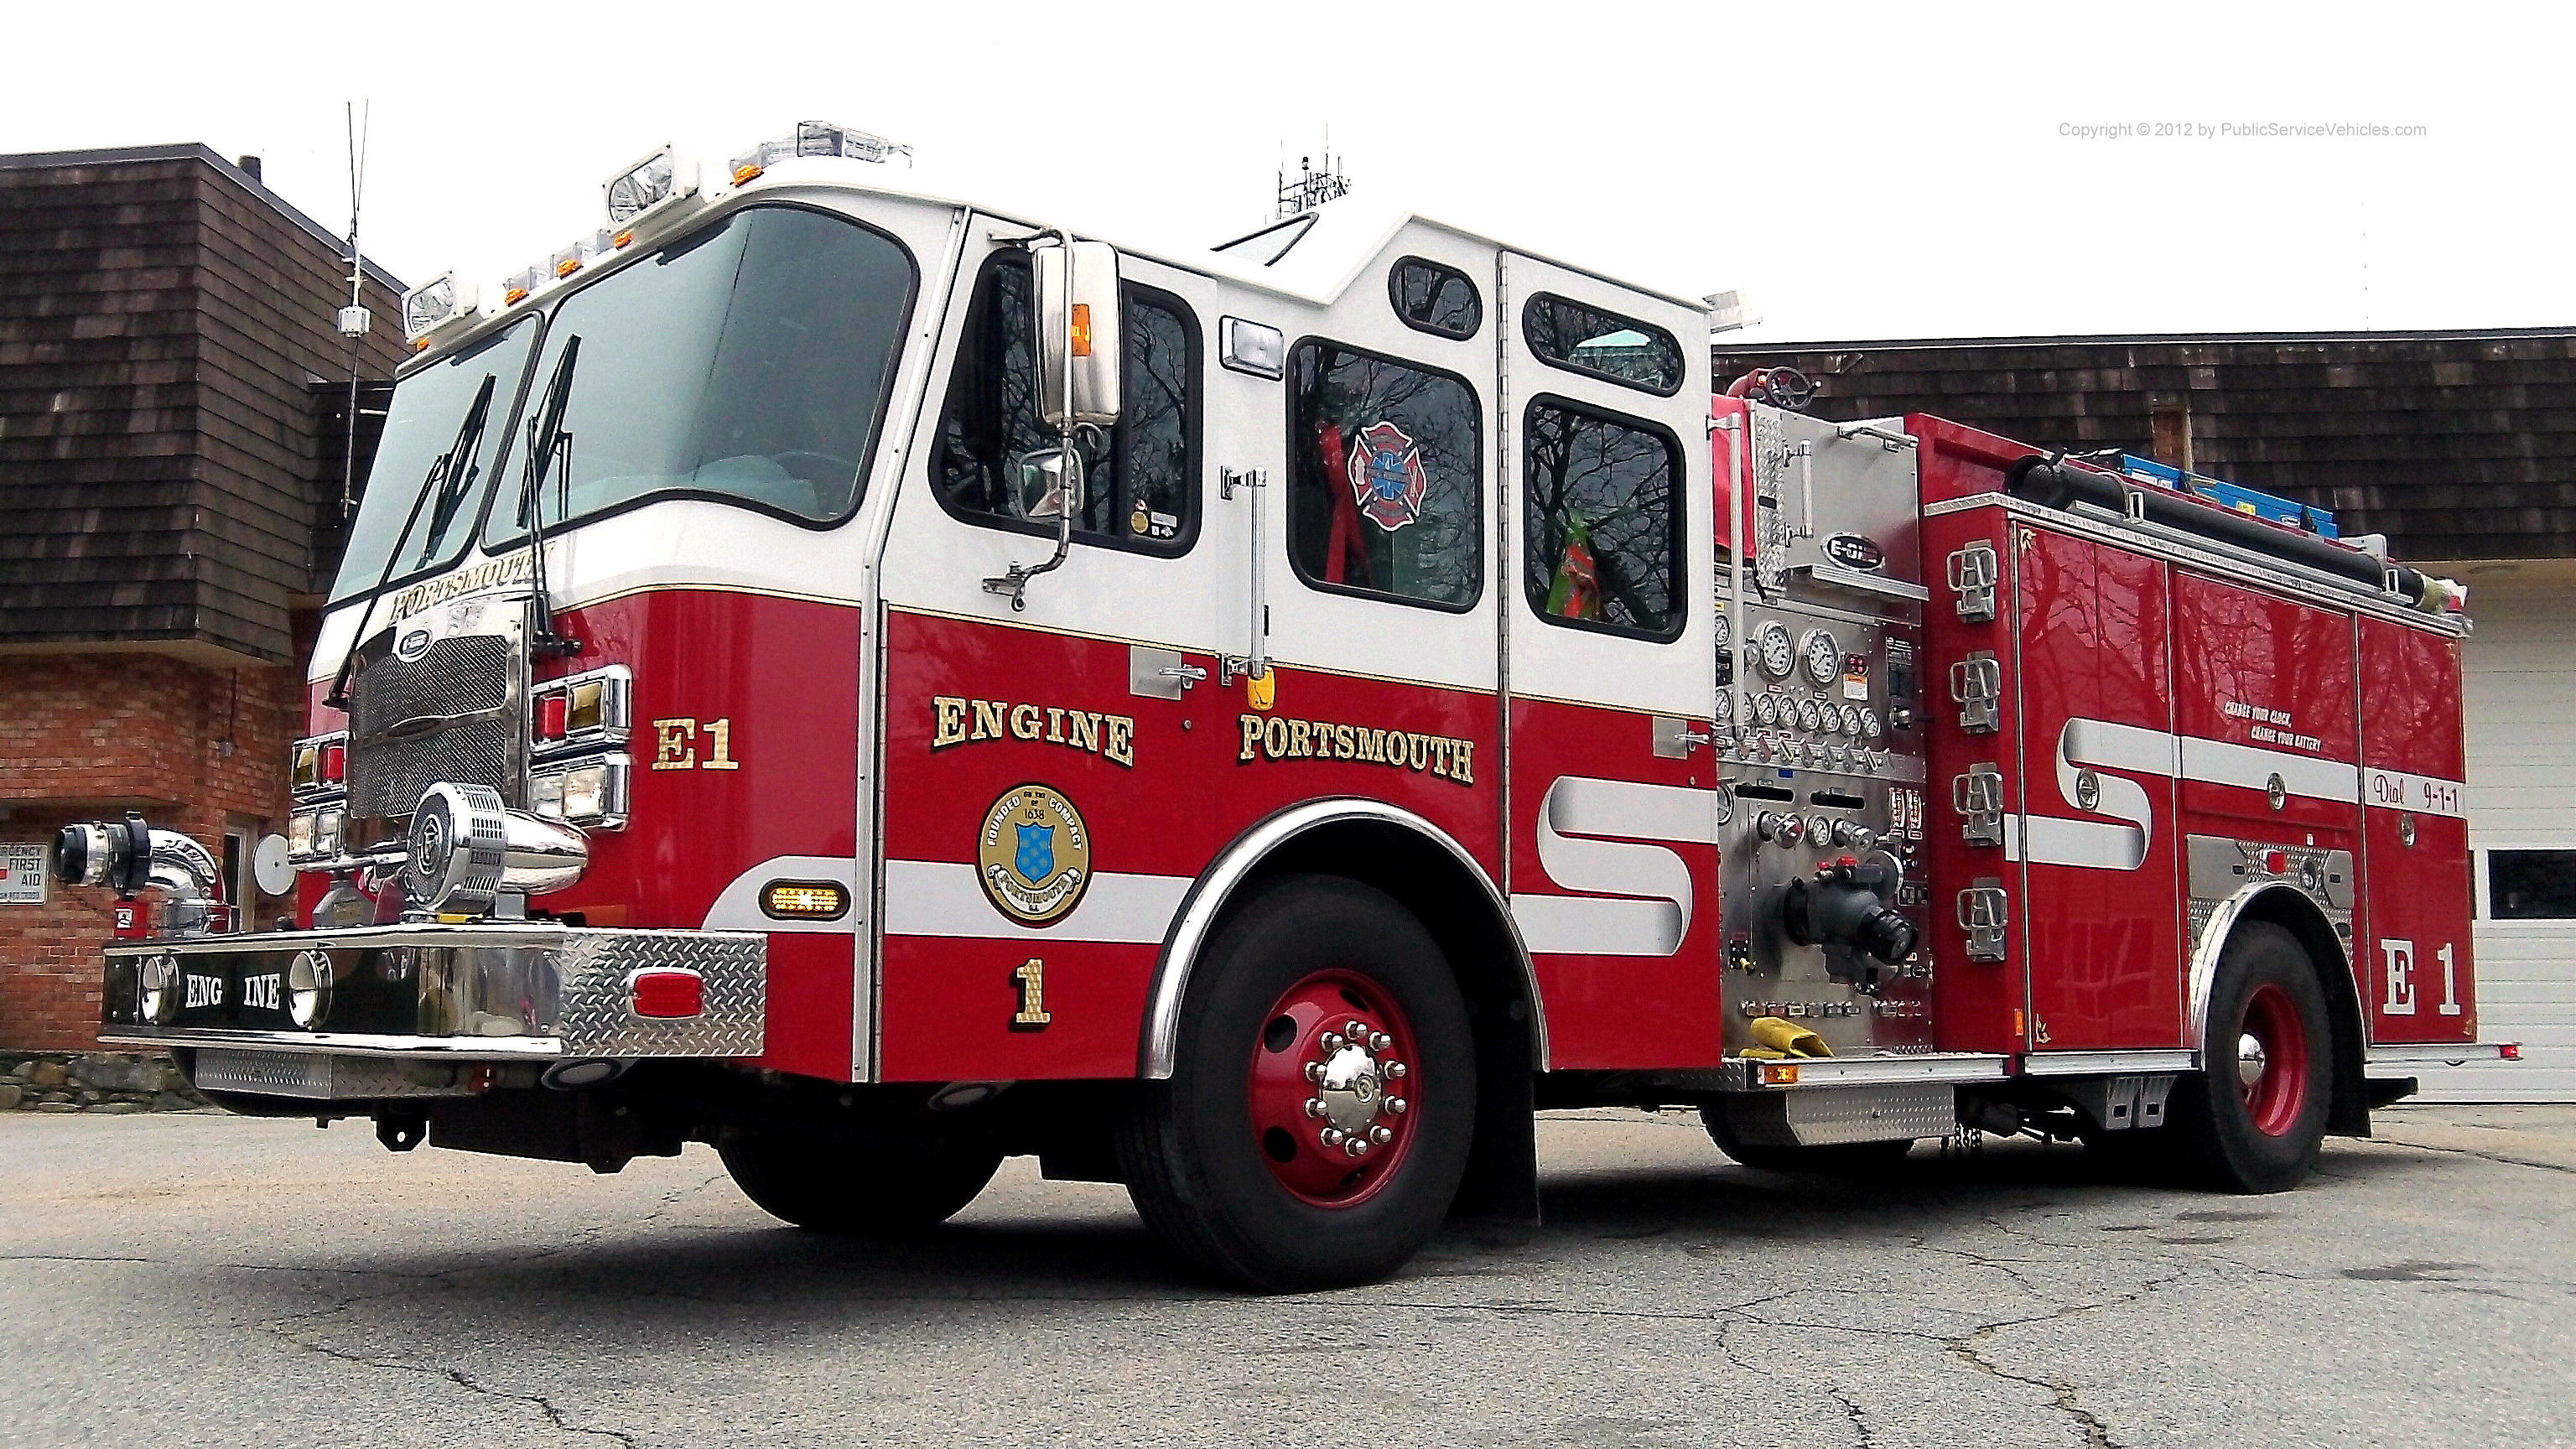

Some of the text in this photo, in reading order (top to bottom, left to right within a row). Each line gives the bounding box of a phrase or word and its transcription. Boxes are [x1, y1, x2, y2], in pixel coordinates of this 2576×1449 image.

[1831, 539, 1877, 564] E-O
[932, 695, 1135, 767] ENGINE
[2225, 700, 2251, 719] CHANGE
[2252, 707, 2269, 722] YOUR
[652, 717, 740, 770] E1
[1239, 714, 1474, 783] PORTSMOUTH
[2251, 725, 2277, 743] CHANGE
[2277, 732, 2294, 746] YOUR
[2373, 774, 2459, 813] Dial 9-1-1
[987, 795, 1021, 847] FOUNDED
[1048, 797, 1083, 850] COMPACT
[8, 858, 42, 871] FIRST
[21, 873, 40, 886] AID
[1015, 958, 1051, 1024] 1
